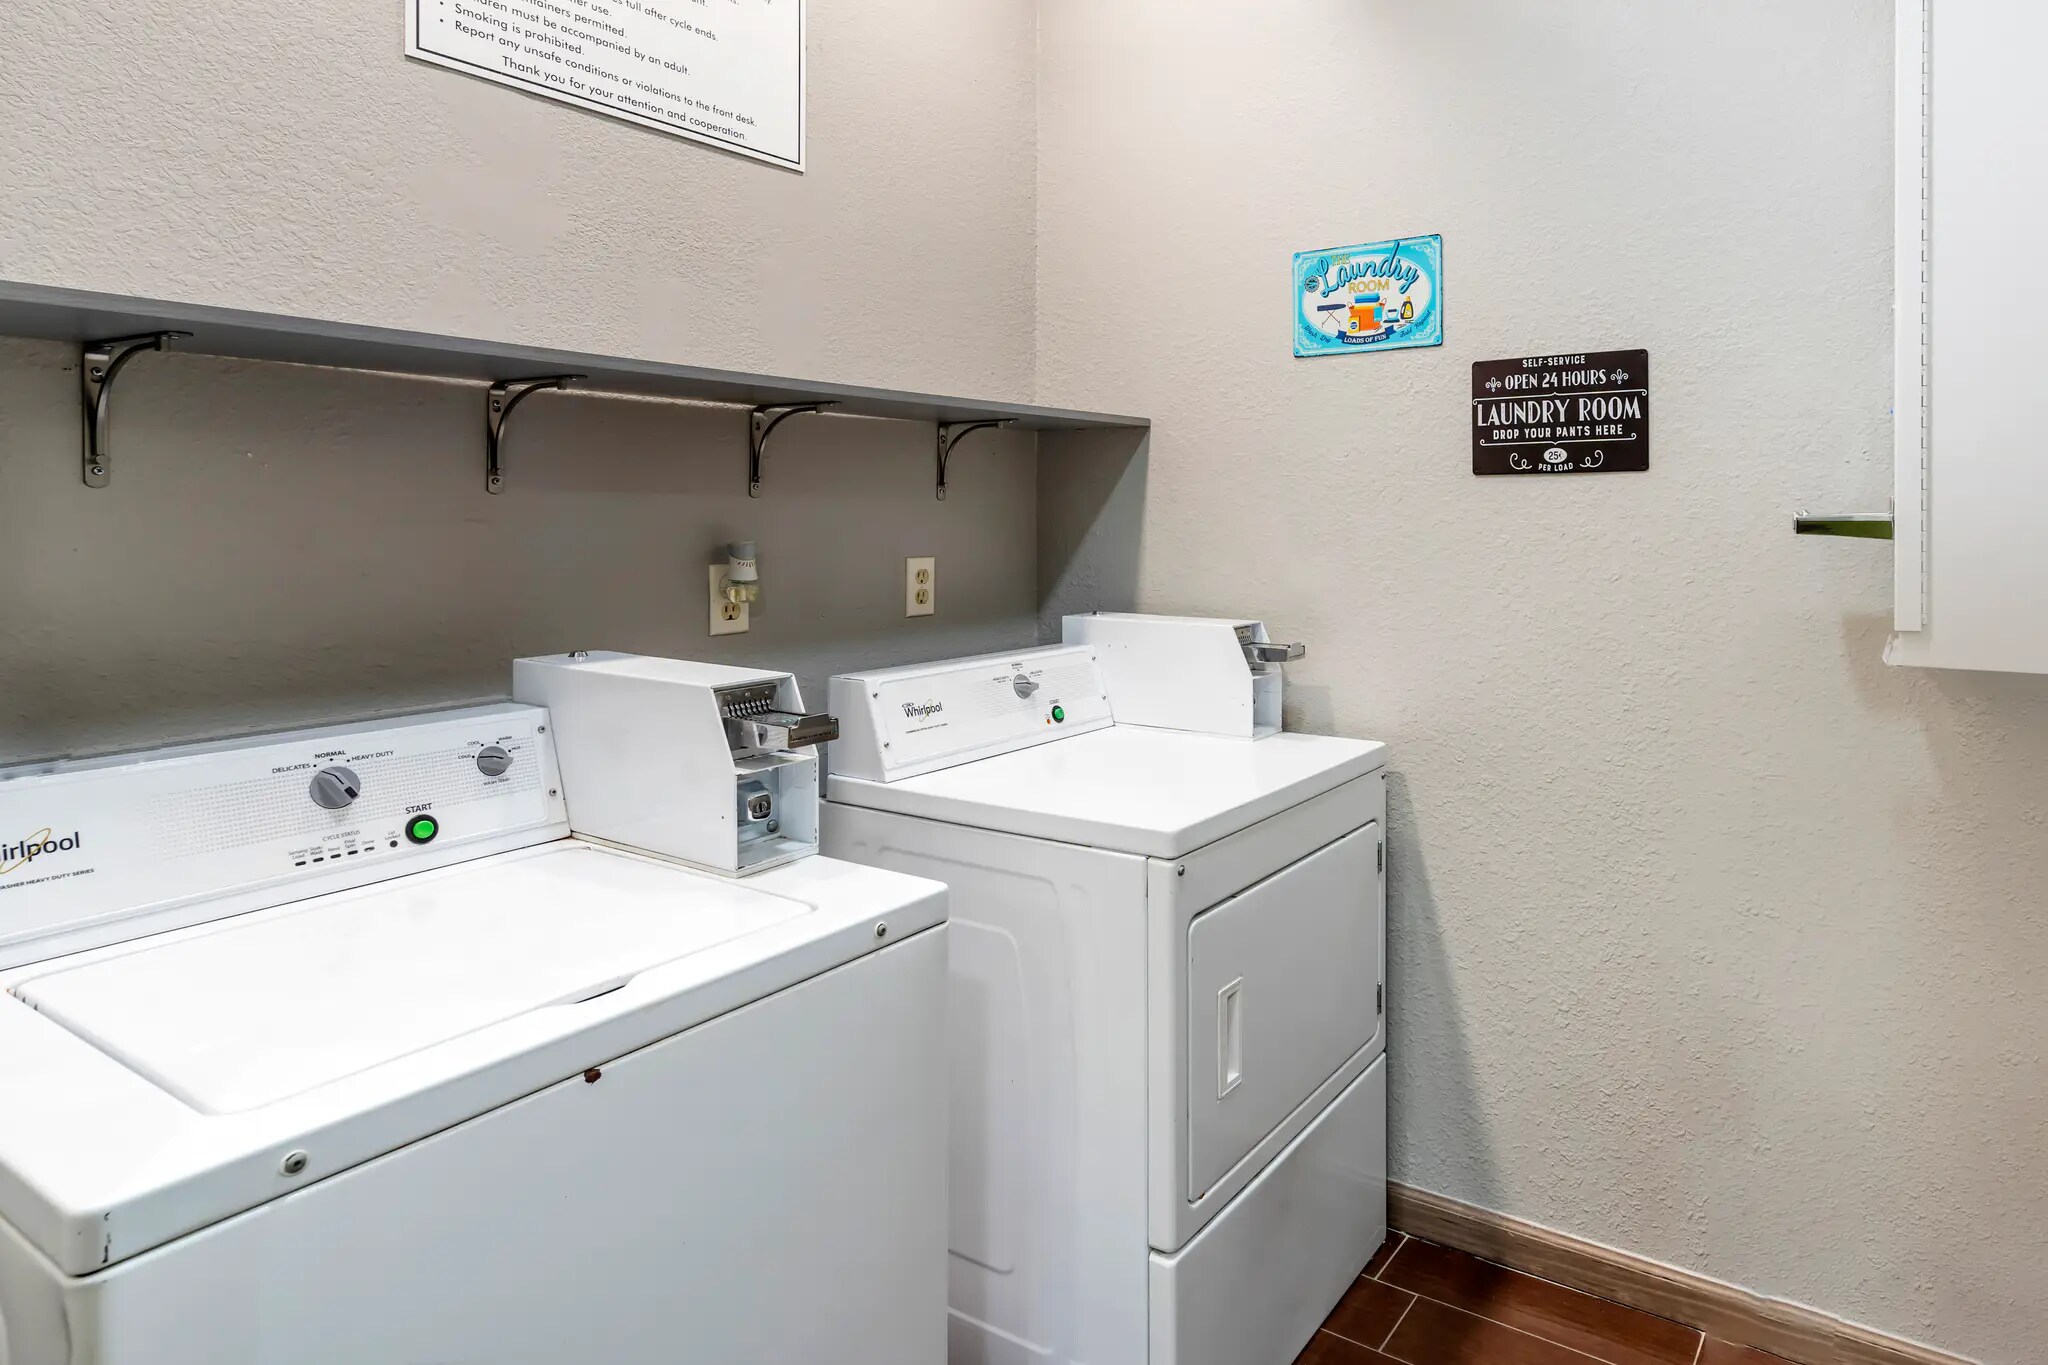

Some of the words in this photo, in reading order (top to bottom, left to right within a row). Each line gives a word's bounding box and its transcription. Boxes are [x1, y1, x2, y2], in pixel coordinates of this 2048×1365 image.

[591, 3, 612, 17] use.
[455, 3, 508, 32] Smoking
[512, 23, 521, 34] is
[525, 29, 585, 55] prohibited.
[574, 13, 628, 38] permitted.
[645, 8, 667, 21] after
[669, 18, 692, 32] cycle
[695, 27, 719, 42] ends.
[511, 8, 540, 23] must
[543, 16, 557, 30] be
[560, 24, 631, 55] accompanied
[634, 48, 646, 62] by
[648, 55, 661, 66] an
[664, 61, 690, 76] adult.
[455, 20, 495, 42] Report
[499, 37, 521, 51] any
[524, 45, 562, 63] unsafe
[565, 59, 619, 82] conditions
[622, 77, 633, 86] or
[635, 81, 681, 102] violations
[684, 96, 693, 106] to
[695, 100, 710, 112] the
[712, 105, 734, 119] front
[736, 113, 758, 127] desk.
[502, 55, 540, 77] Thank
[544, 72, 566, 85] you
[569, 77, 586, 90] for
[589, 86, 614, 99] your
[617, 94, 664, 115] attention
[667, 109, 686, 122] and
[689, 117, 748, 140] cooperation.
[1315, 240, 1419, 298] Laundry
[1348, 279, 1390, 295] ROOM
[1344, 335, 1365, 343] LOADS
[1374, 334, 1387, 342] FUN
[1522, 355, 1586, 368] SELF-SERVICE
[1505, 373, 1538, 390] OPEN
[1542, 372, 1558, 388] 24
[1562, 369, 1607, 387] HOURS
[1477, 398, 1570, 427] LAUNDRY
[1578, 396, 1642, 422] ROOM
[1493, 428, 1520, 440] DROP
[1524, 427, 1551, 439] YOUR
[1556, 426, 1591, 437] PANTS
[1595, 424, 1623, 436] HERE
[1538, 463, 1552, 471] PER
[1554, 462, 1574, 472] LOAD
[904, 701, 943, 718] Whirlpool
[314, 750, 347, 759] NORMAL
[351, 753, 374, 761] HEAVY
[375, 750, 394, 758] DUTY
[272, 763, 311, 774] DELICATES
[405, 803, 433, 815] START
[322, 834, 340, 842] CYCLE
[340, 830, 361, 838] STATUS
[0, 831, 80, 862] irlpool
[0, 881, 25, 890] ASHER
[26, 876, 50, 885] HEAVY
[51, 872, 71, 880] DUTY
[72, 868, 95, 876] SERIES
